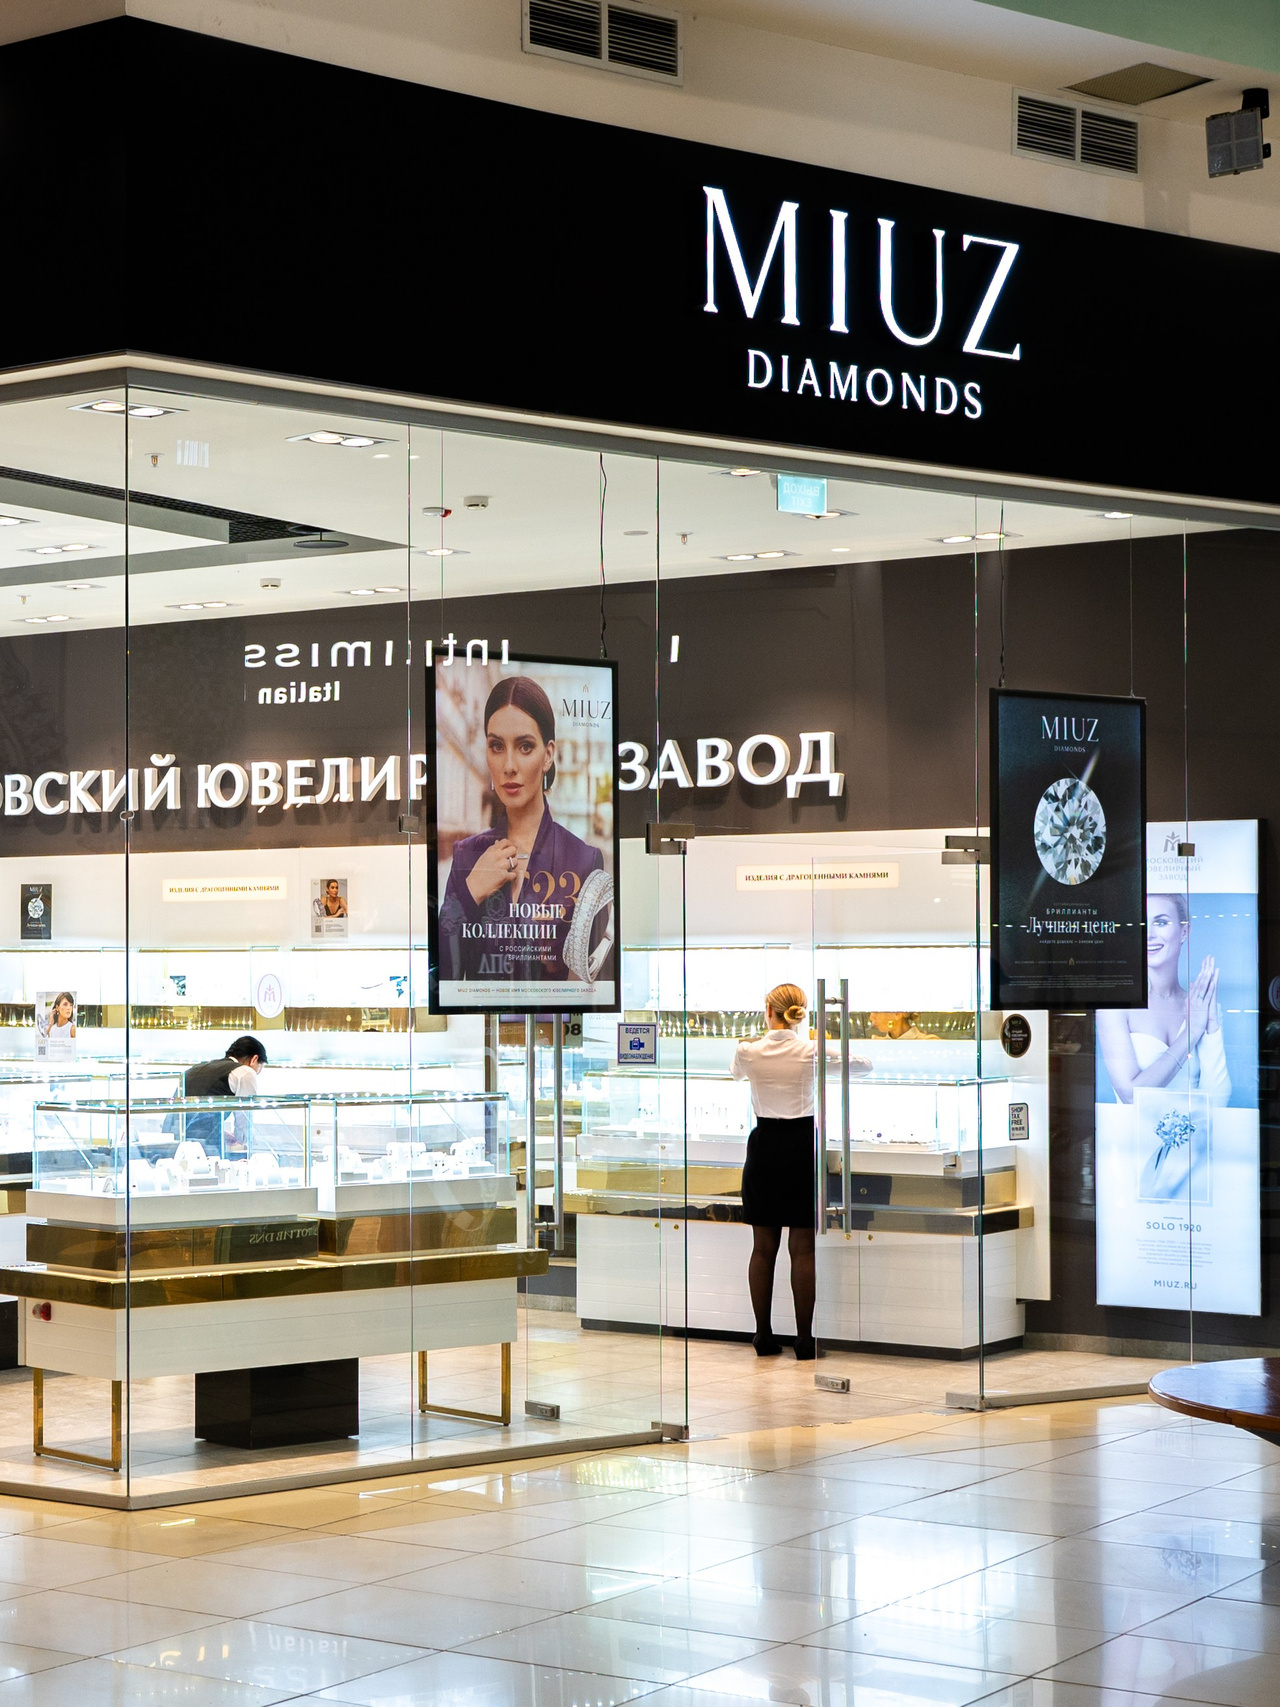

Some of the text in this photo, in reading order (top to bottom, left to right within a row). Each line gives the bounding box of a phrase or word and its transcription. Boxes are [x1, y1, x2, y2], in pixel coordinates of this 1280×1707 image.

[703, 186, 1020, 360] MIUZ
[747, 349, 982, 419] DIAMONDS
[562, 698, 611, 720] MIUZ
[1041, 715, 1100, 743] MIUZ
[618, 731, 845, 798] ЗАВОД
[509, 903, 564, 919] НОВЫЕ
[462, 923, 557, 942] КОЛЛЕКЦИИ
[1026, 916, 1116, 937] Лучшая цена
[1011, 1106, 1023, 1114] SHOP
[1146, 1221, 1202, 1232] SOLO 1920
[1153, 1280, 1198, 1290] MIUZ.RU
